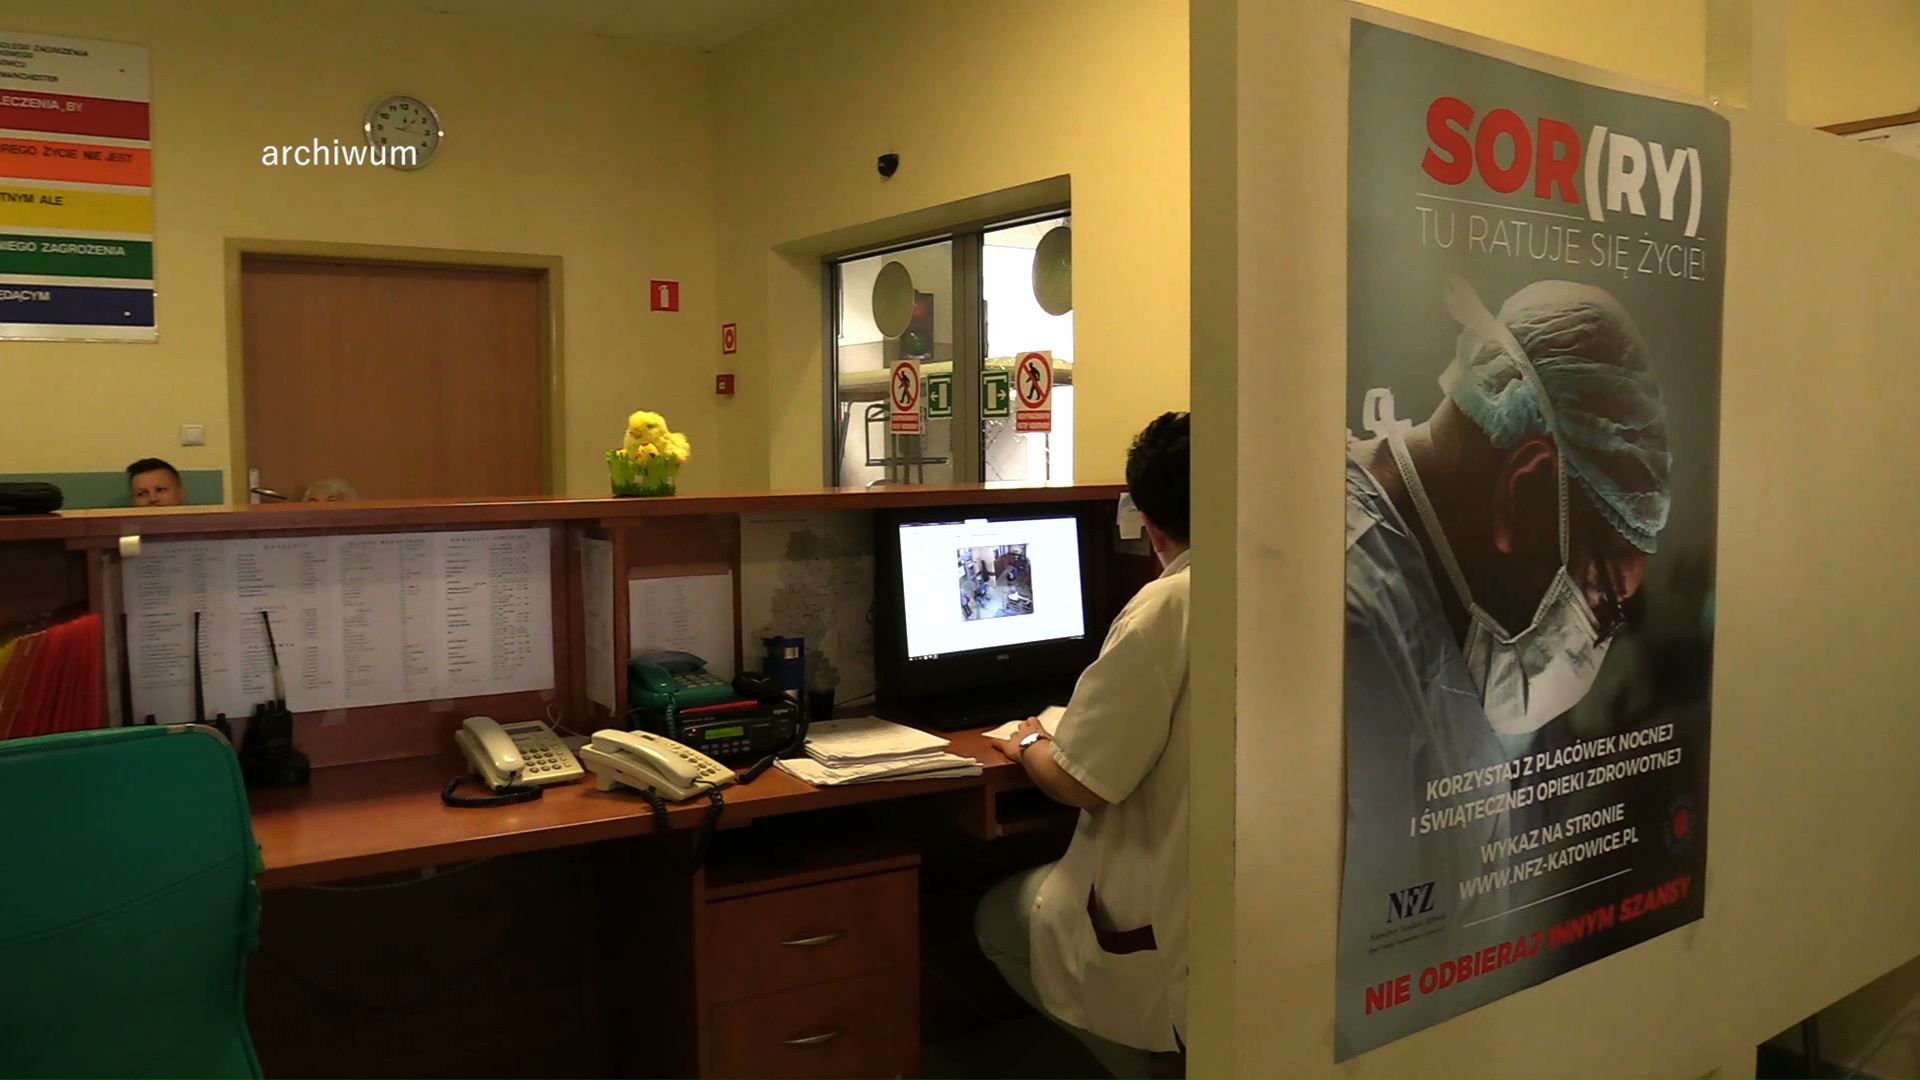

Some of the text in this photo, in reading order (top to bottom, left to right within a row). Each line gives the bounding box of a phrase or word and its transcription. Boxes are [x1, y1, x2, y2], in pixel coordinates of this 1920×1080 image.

[40, 195, 64, 207] ALE
[1421, 96, 1703, 238] SOR(RY)
[1415, 206, 1455, 249] TU
[1468, 214, 1582, 265] RATUJE
[1590, 232, 1630, 279] SIĘ
[1409, 747, 1683, 838] I ŚWIĄTECZNEJ OPIEKI ZDROWOTNEJ
[1425, 723, 1675, 802] KORZYSTAJ Z PLACÓWEK NOCNEJ
[1458, 826, 1640, 900] WWW.NFZ-KATOWICE.PL
[1480, 803, 1626, 865] WYKAZ NA STRONIE
[1385, 880, 1436, 924] NFZ
[1364, 974, 1412, 1016] NIE
[1418, 928, 1543, 995] ODBIERAJ
[1547, 903, 1615, 951] INNYM
[1618, 874, 1692, 923] SZANSY
